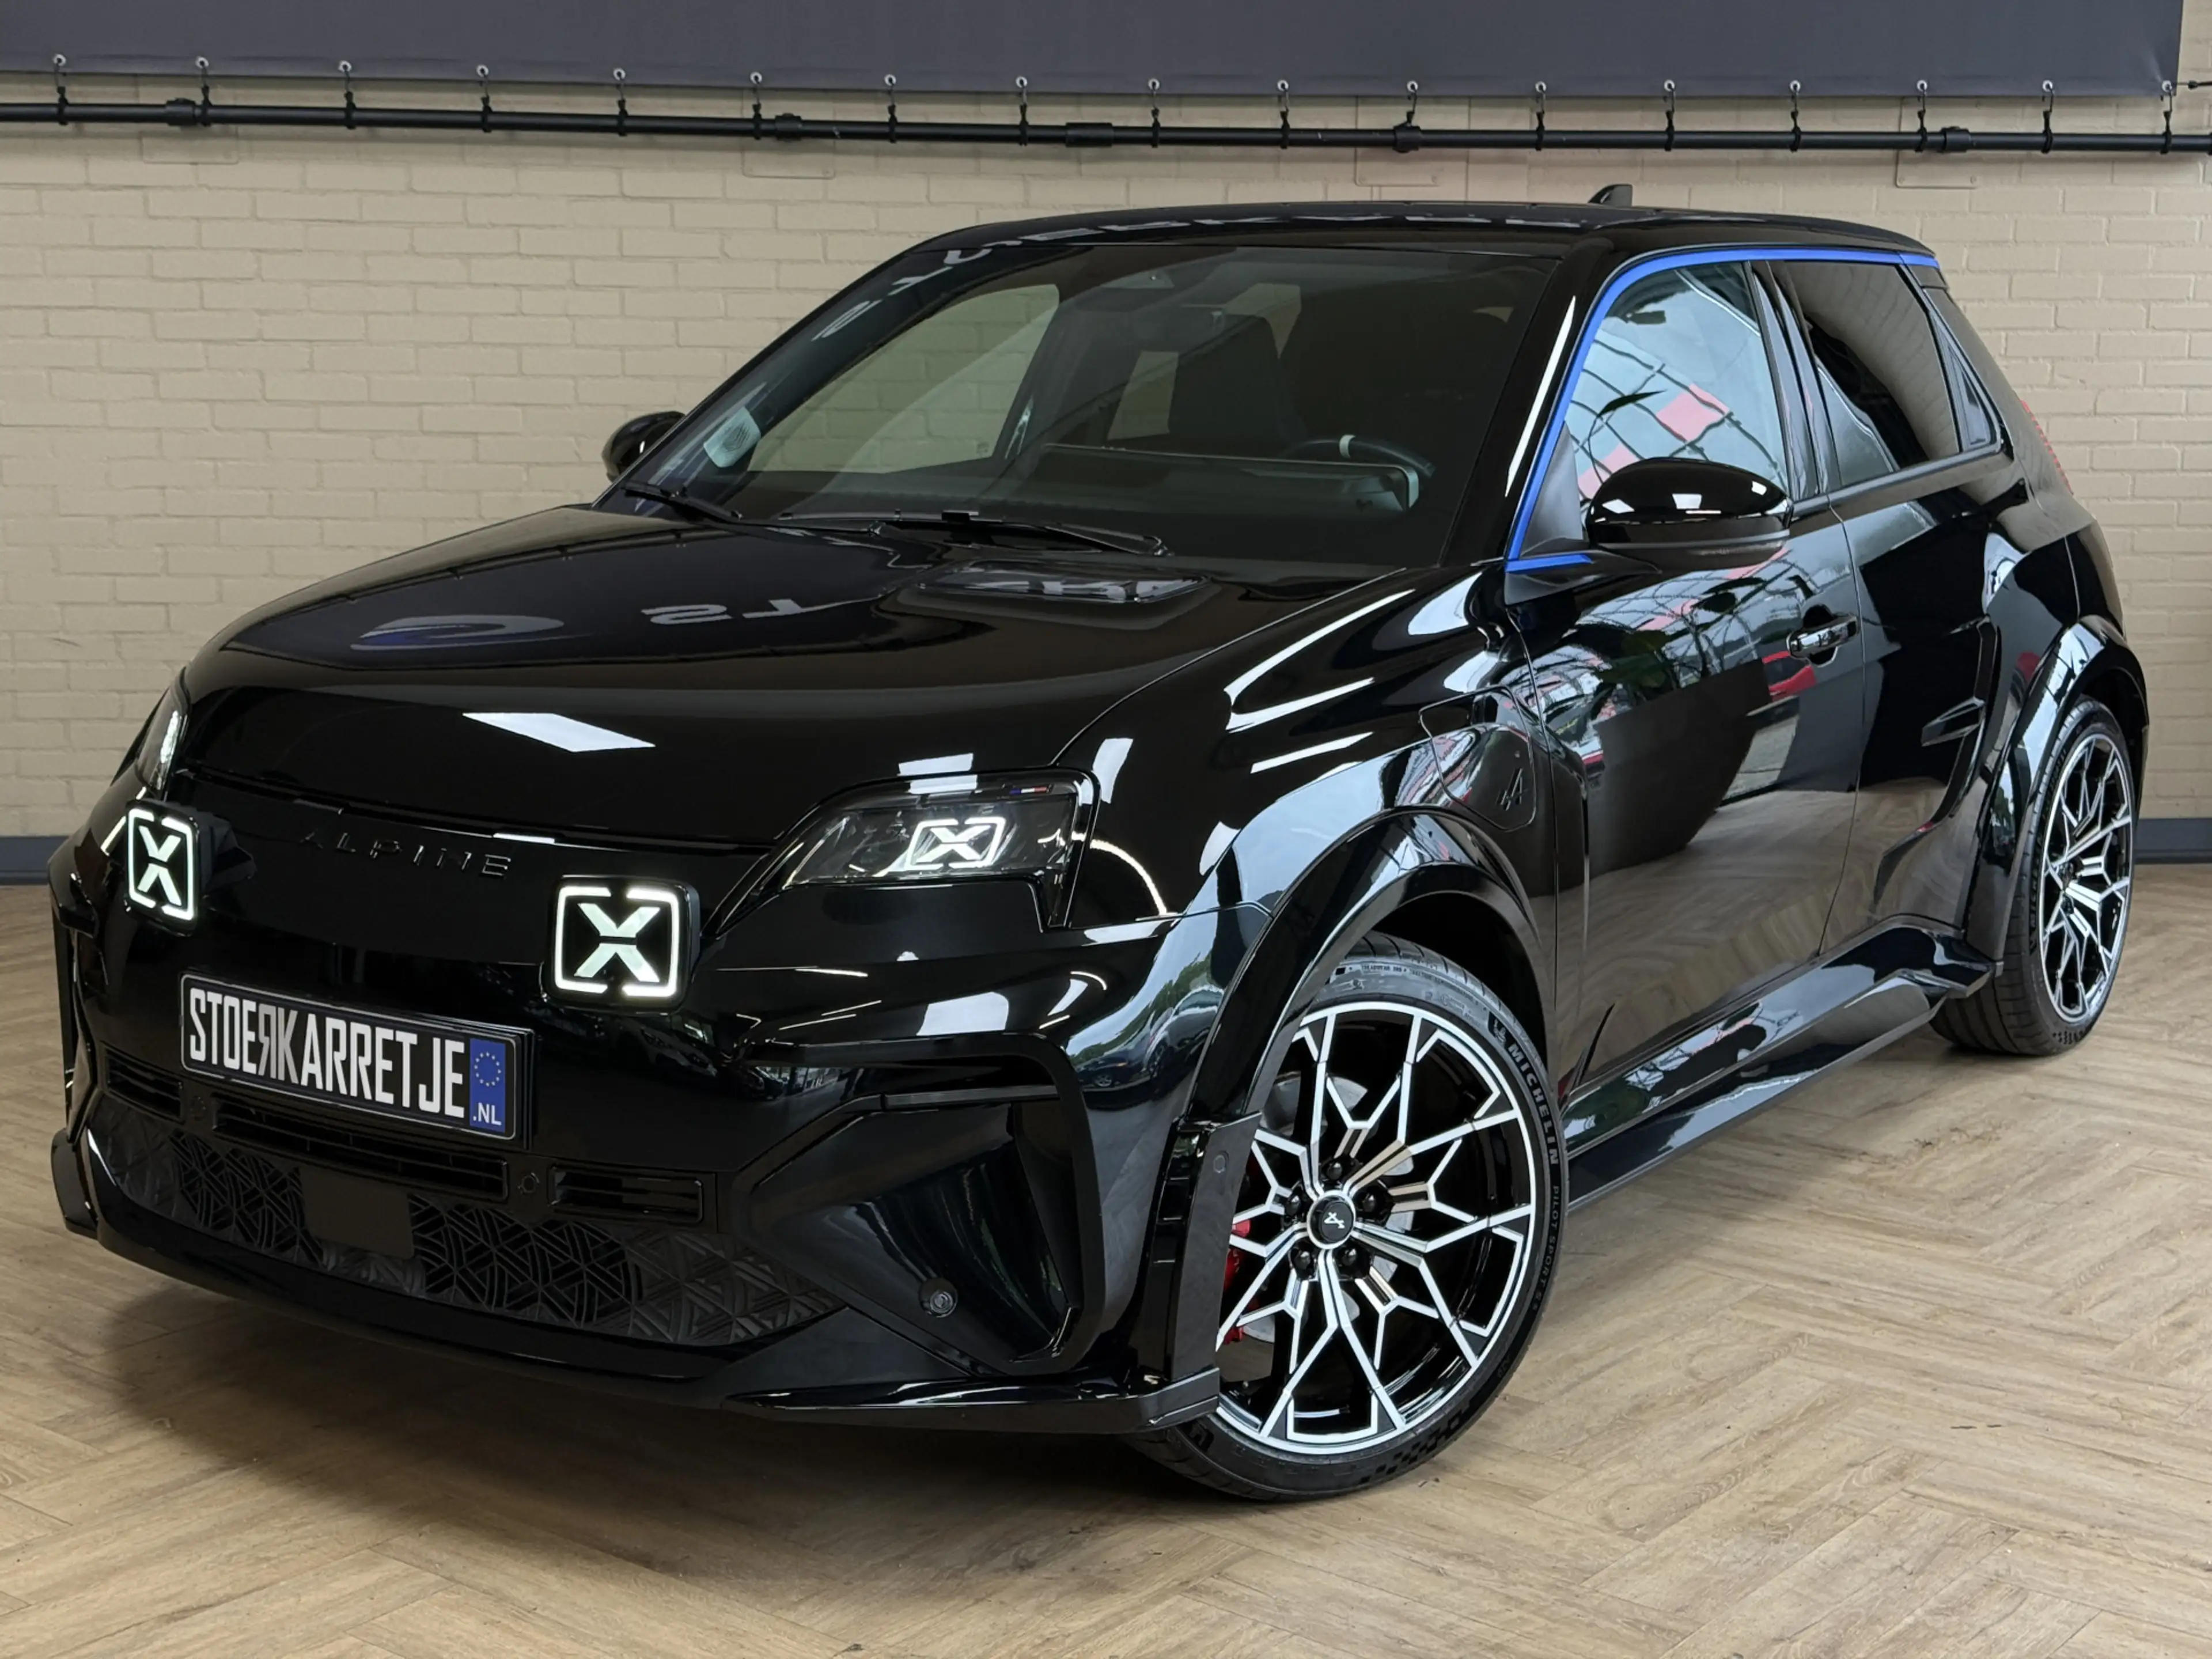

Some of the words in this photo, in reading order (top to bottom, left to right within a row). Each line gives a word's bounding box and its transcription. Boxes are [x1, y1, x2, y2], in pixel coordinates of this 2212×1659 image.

[190, 987, 465, 1118] STOERKARRETJE
[1508, 1044, 1559, 1165] MICHELIN
[1550, 1185, 1559, 1229] PILOT
[1539, 1236, 1556, 1287] SPORT
